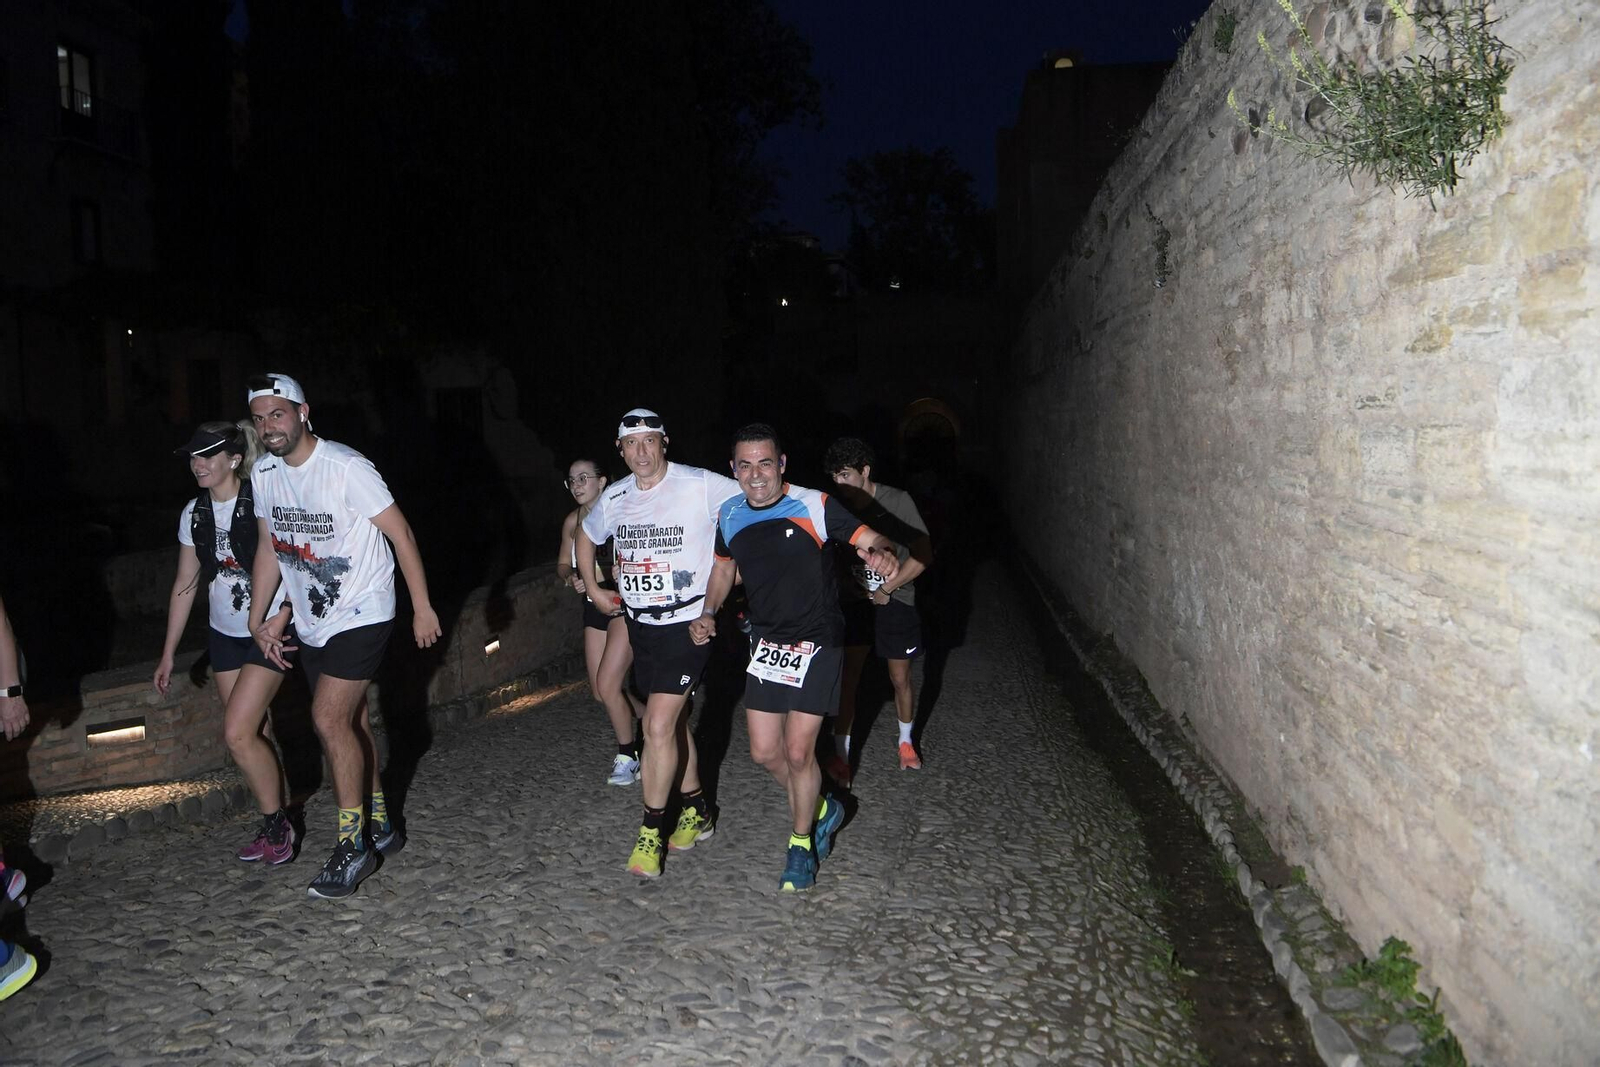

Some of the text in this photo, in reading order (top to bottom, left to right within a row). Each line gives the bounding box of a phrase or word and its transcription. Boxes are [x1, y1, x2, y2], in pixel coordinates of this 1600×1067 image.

[272, 506, 283, 521] 40
[616, 524, 626, 540] 40
[628, 525, 684, 539] MEDIA MARATÓN
[638, 540, 647, 549] DE
[648, 536, 683, 549] GRANADA
[623, 574, 664, 592] 3153
[756, 647, 802, 671] 2964
